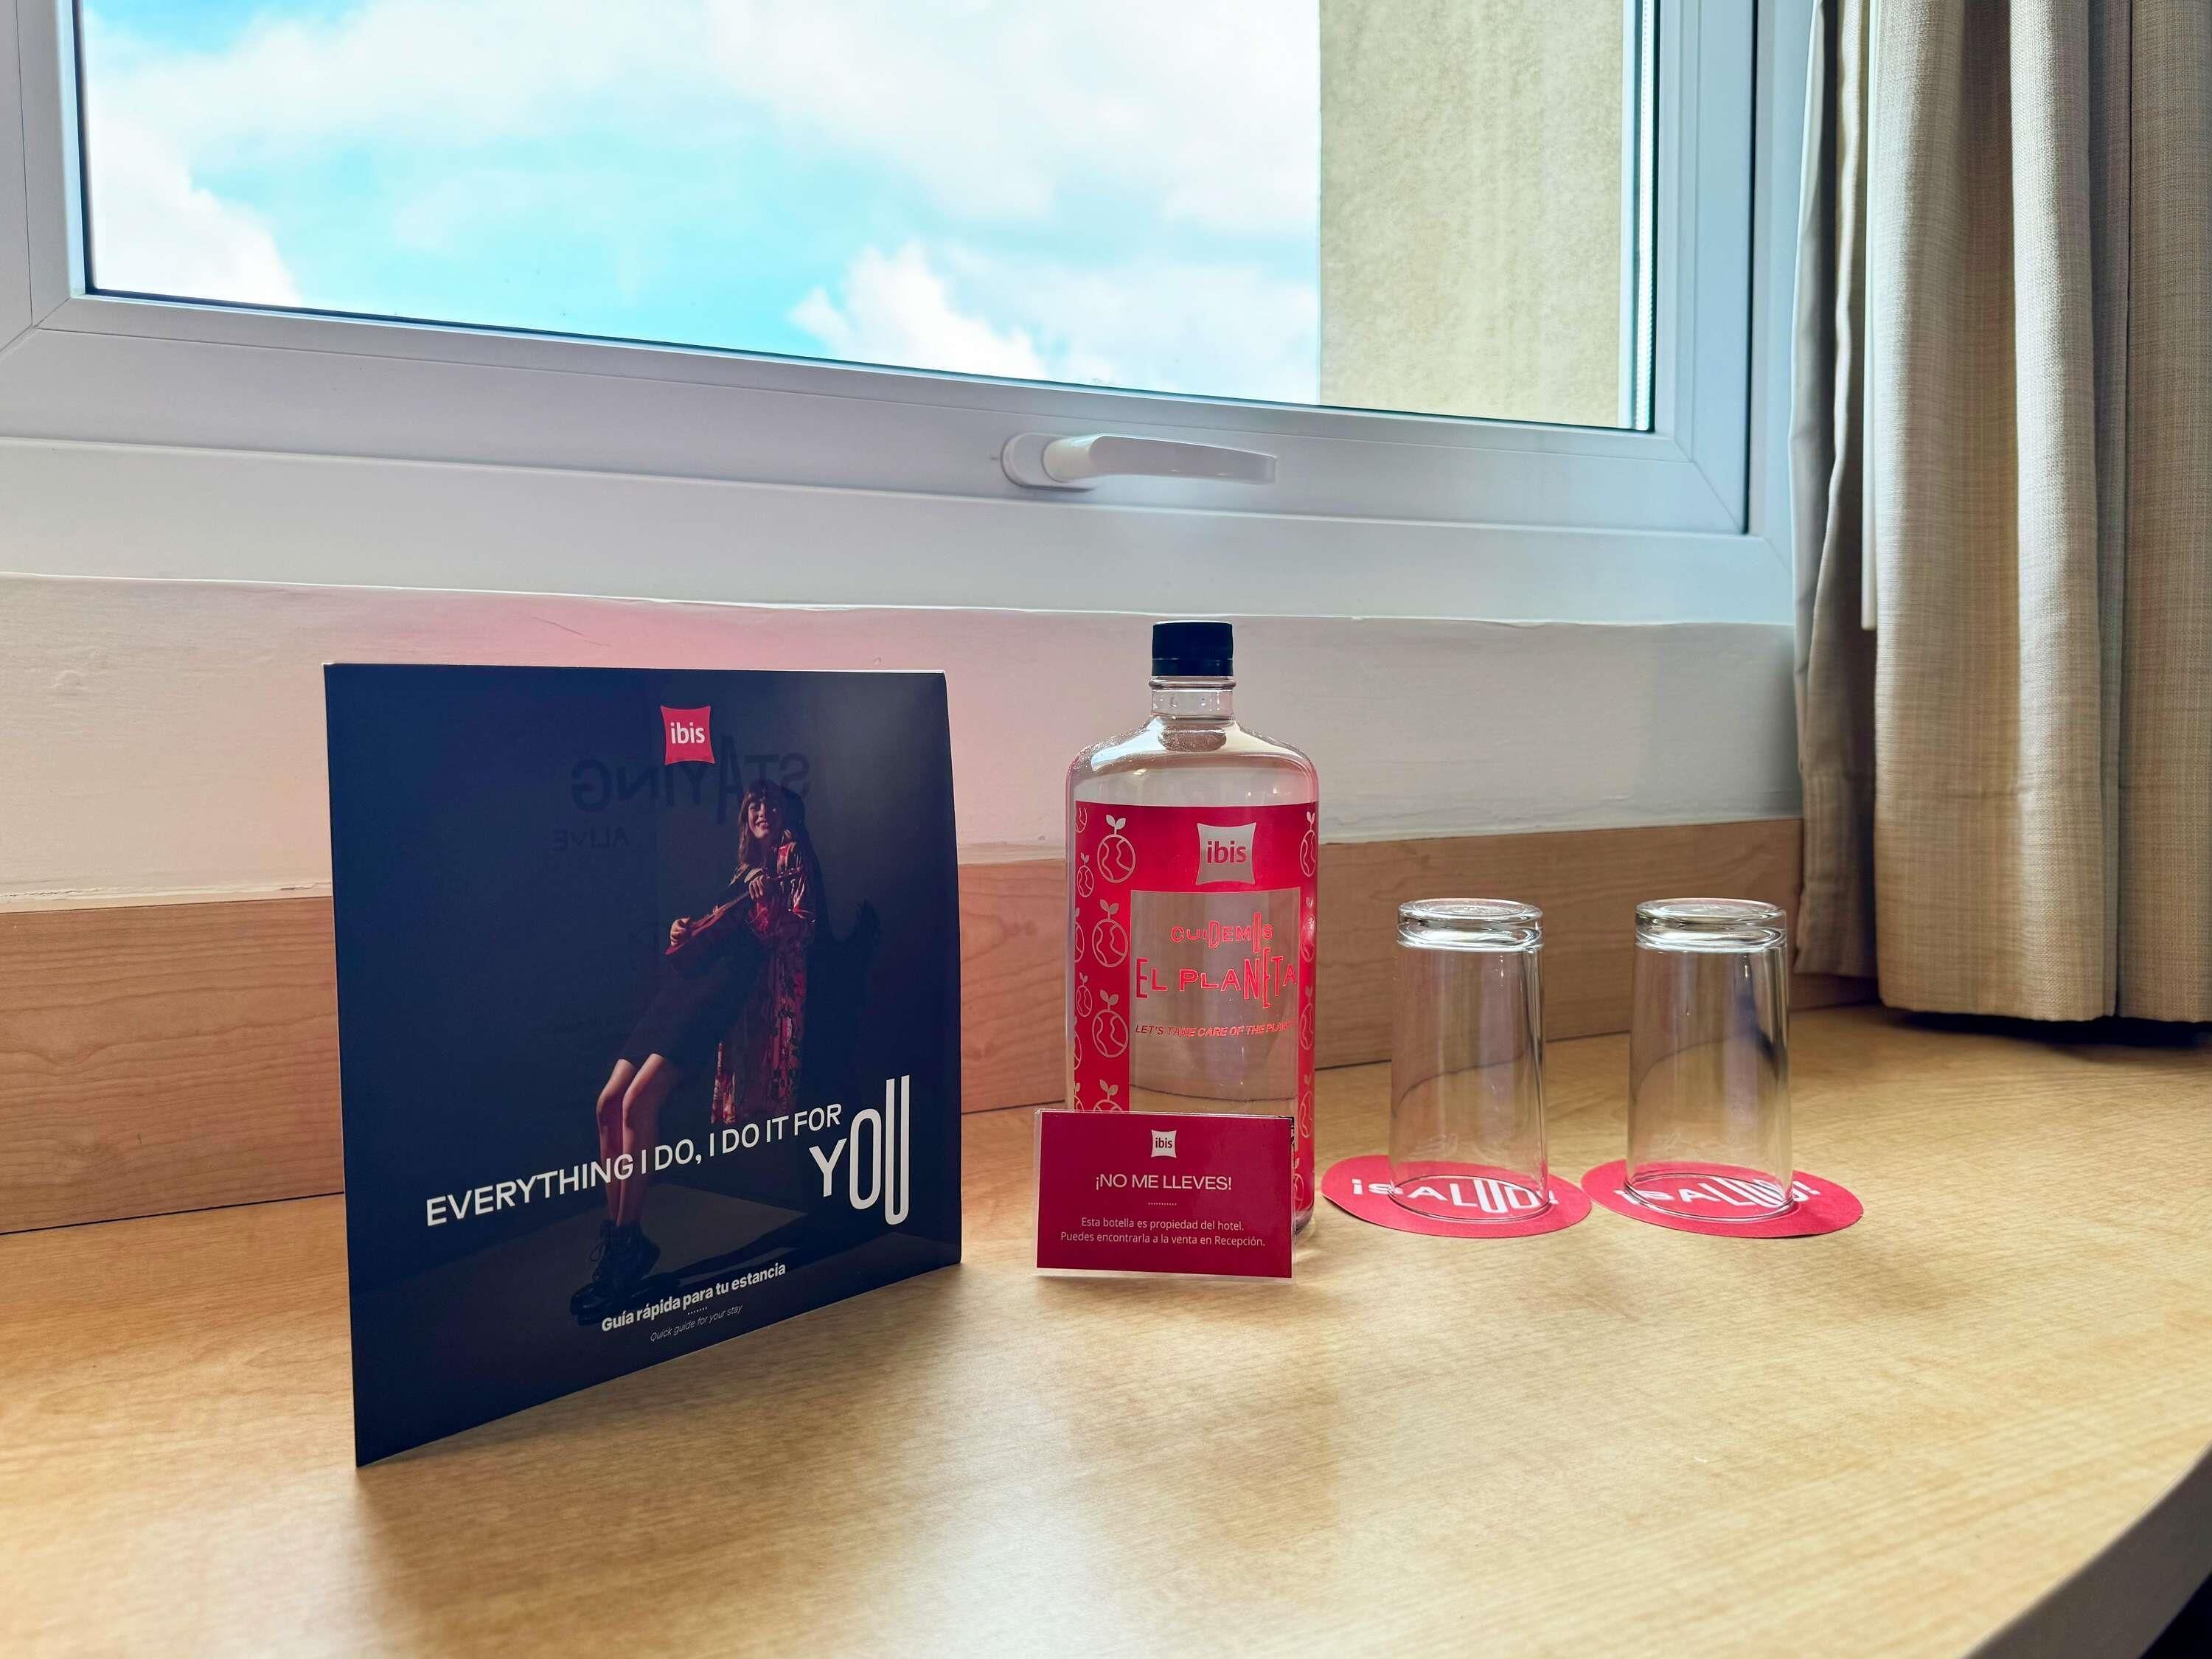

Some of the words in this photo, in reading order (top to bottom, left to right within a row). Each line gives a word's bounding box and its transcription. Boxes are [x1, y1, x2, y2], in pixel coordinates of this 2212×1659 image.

[669, 721, 706, 745] ibis
[1206, 840, 1247, 864] ibis
[1170, 912, 1274, 953] CUIDEMOS
[1135, 956, 1168, 999] EL
[1179, 947, 1298, 1009] PLANETA
[1135, 1024, 1164, 1035] LET'S
[1167, 1026, 1197, 1038] TAKE
[1197, 1026, 1228, 1038] CARE
[1229, 1025, 1245, 1037] OF
[1245, 1025, 1266, 1035] THE
[809, 1074, 911, 1225] YOU
[1155, 1137, 1173, 1149] ibis
[426, 1153, 634, 1227] EVERYTHING
[641, 1149, 647, 1174] I
[654, 1138, 702, 1171] DO,
[709, 1133, 715, 1157] I
[722, 1123, 759, 1154] DO
[766, 1116, 789, 1143] IT
[794, 1103, 843, 1136] FOR
[1096, 1173, 1127, 1190] ¡NO
[1132, 1174, 1159, 1189] ME
[1162, 1175, 1233, 1191] LLEVES!
[1081, 1217, 1101, 1228] Esta
[1102, 1217, 1135, 1228] botella
[1136, 1220, 1148, 1228] es
[1150, 1219, 1198, 1233] propiedad
[1200, 1220, 1215, 1230] del
[1217, 1220, 1245, 1231] hotel.
[1060, 1231, 1095, 1243] Puedes
[1096, 1233, 1150, 1244] encontrarla
[1152, 1236, 1158, 1244] a
[1161, 1234, 1169, 1245] la
[1171, 1236, 1197, 1245] venta
[1200, 1237, 1211, 1245] en
[1214, 1235, 1266, 1248] Recepción.
[601, 1308, 634, 1332] Guía
[636, 1297, 681, 1321] rápida
[683, 1287, 714, 1307] para
[715, 1281, 729, 1295] tu
[731, 1262, 787, 1291] estancia
[650, 1326, 672, 1343] Quick
[673, 1318, 696, 1337] guide
[697, 1315, 709, 1326] for
[709, 1309, 727, 1324] your
[727, 1303, 744, 1315] stay
